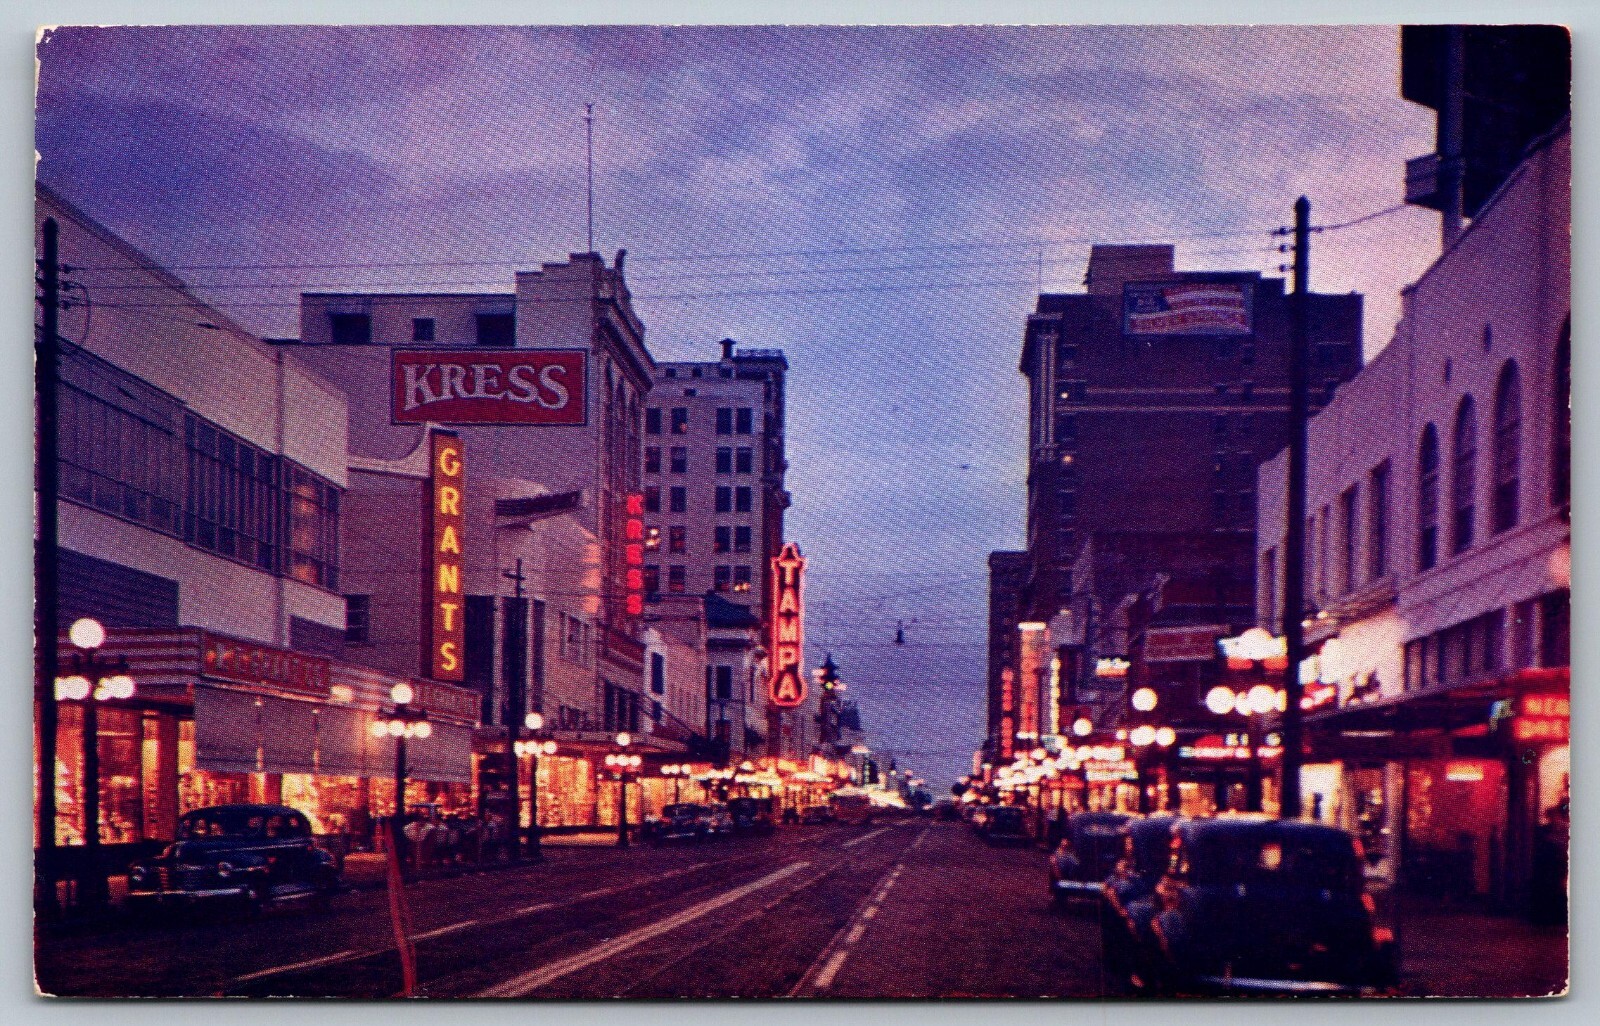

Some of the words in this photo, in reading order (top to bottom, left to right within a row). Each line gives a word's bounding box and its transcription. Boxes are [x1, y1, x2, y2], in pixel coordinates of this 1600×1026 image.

[401, 364, 570, 411] KRESS
[439, 447, 461, 671] GRANTS
[626, 494, 644, 615] KRESS
[778, 559, 802, 701] TAMPA
